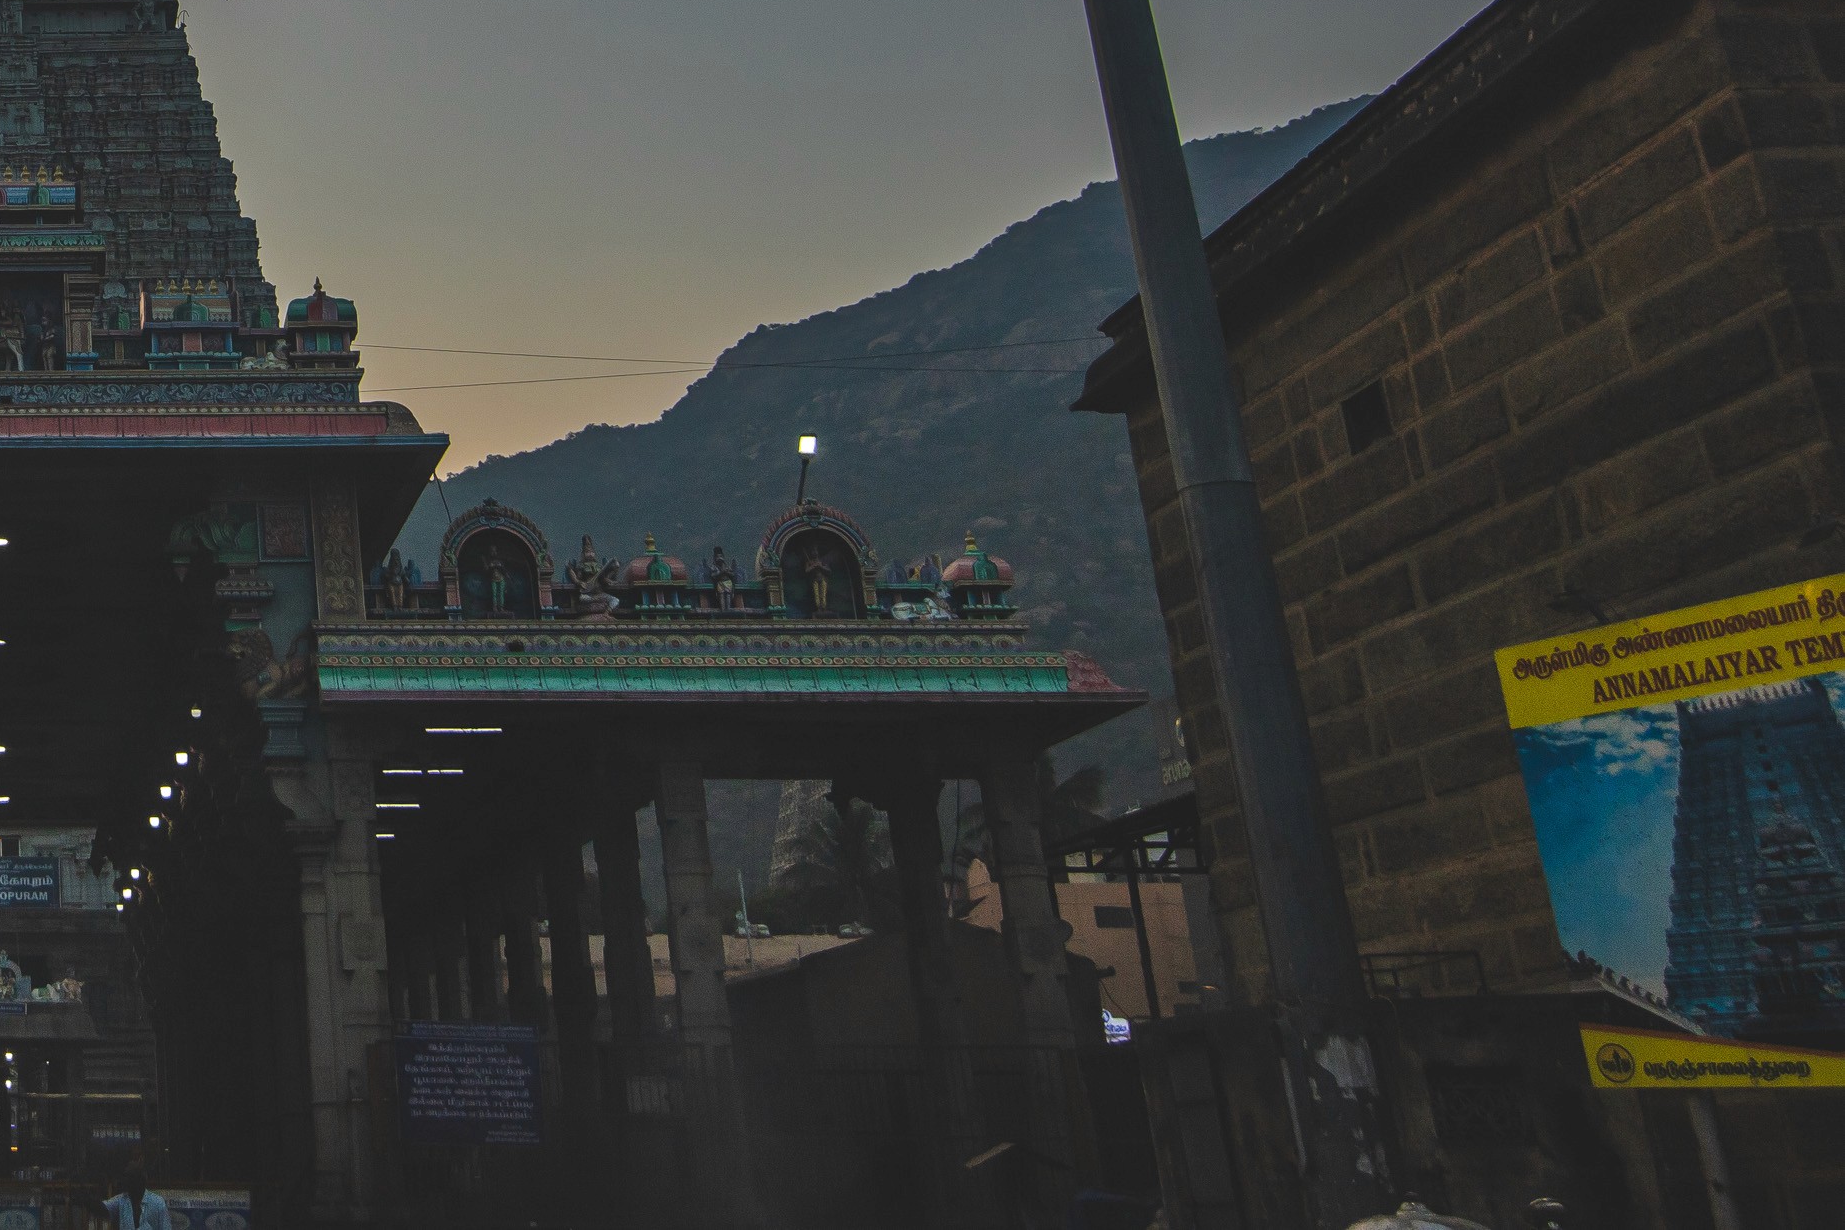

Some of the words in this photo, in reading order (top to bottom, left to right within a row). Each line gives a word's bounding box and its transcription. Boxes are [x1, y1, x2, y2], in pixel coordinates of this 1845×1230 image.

[1512, 641, 1610, 681] அருள்மிகு
[1613, 594, 1811, 659] அண்ணாமலையார்
[1592, 644, 1783, 703] ANNAMALAIYAR
